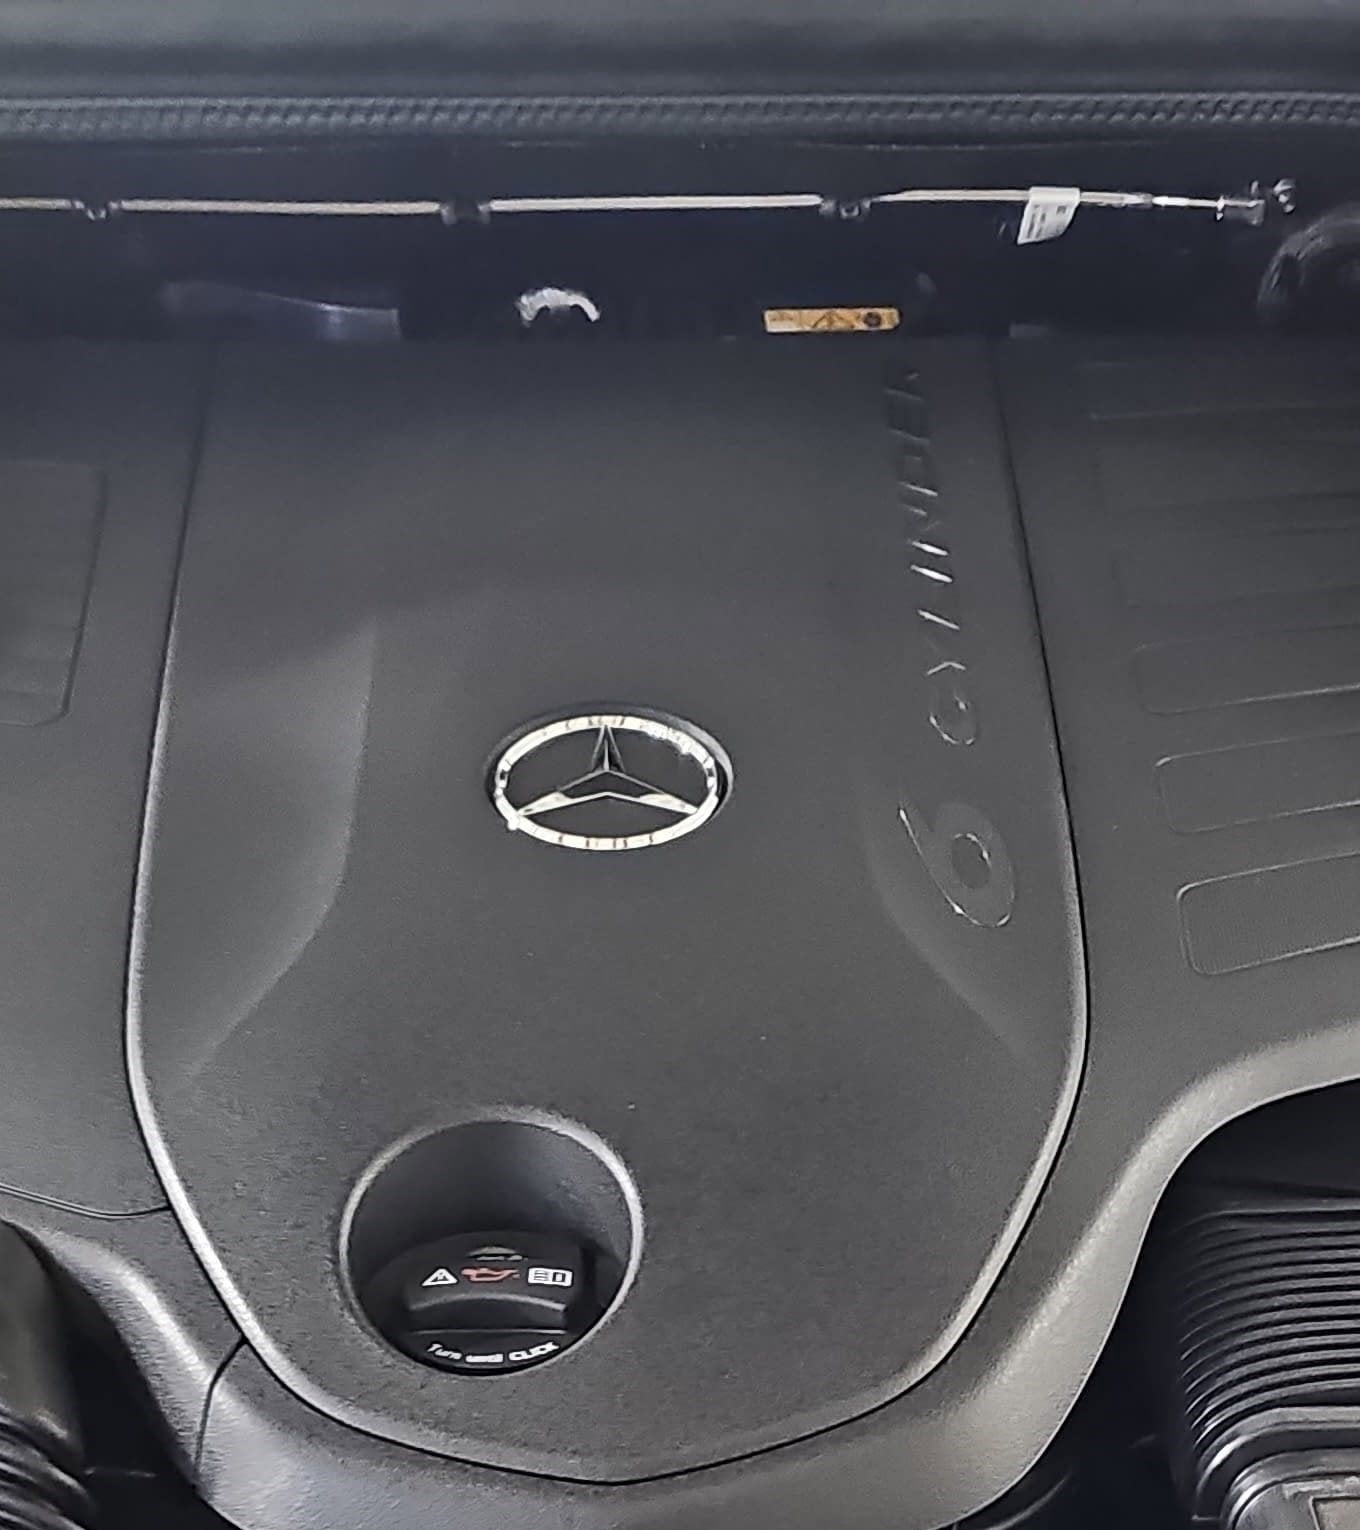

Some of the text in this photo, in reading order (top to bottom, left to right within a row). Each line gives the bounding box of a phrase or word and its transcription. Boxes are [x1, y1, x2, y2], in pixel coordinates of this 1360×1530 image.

[897, 801, 1016, 928] 6
[427, 1343, 462, 1360] Turn
[509, 1342, 559, 1361] CLICK
